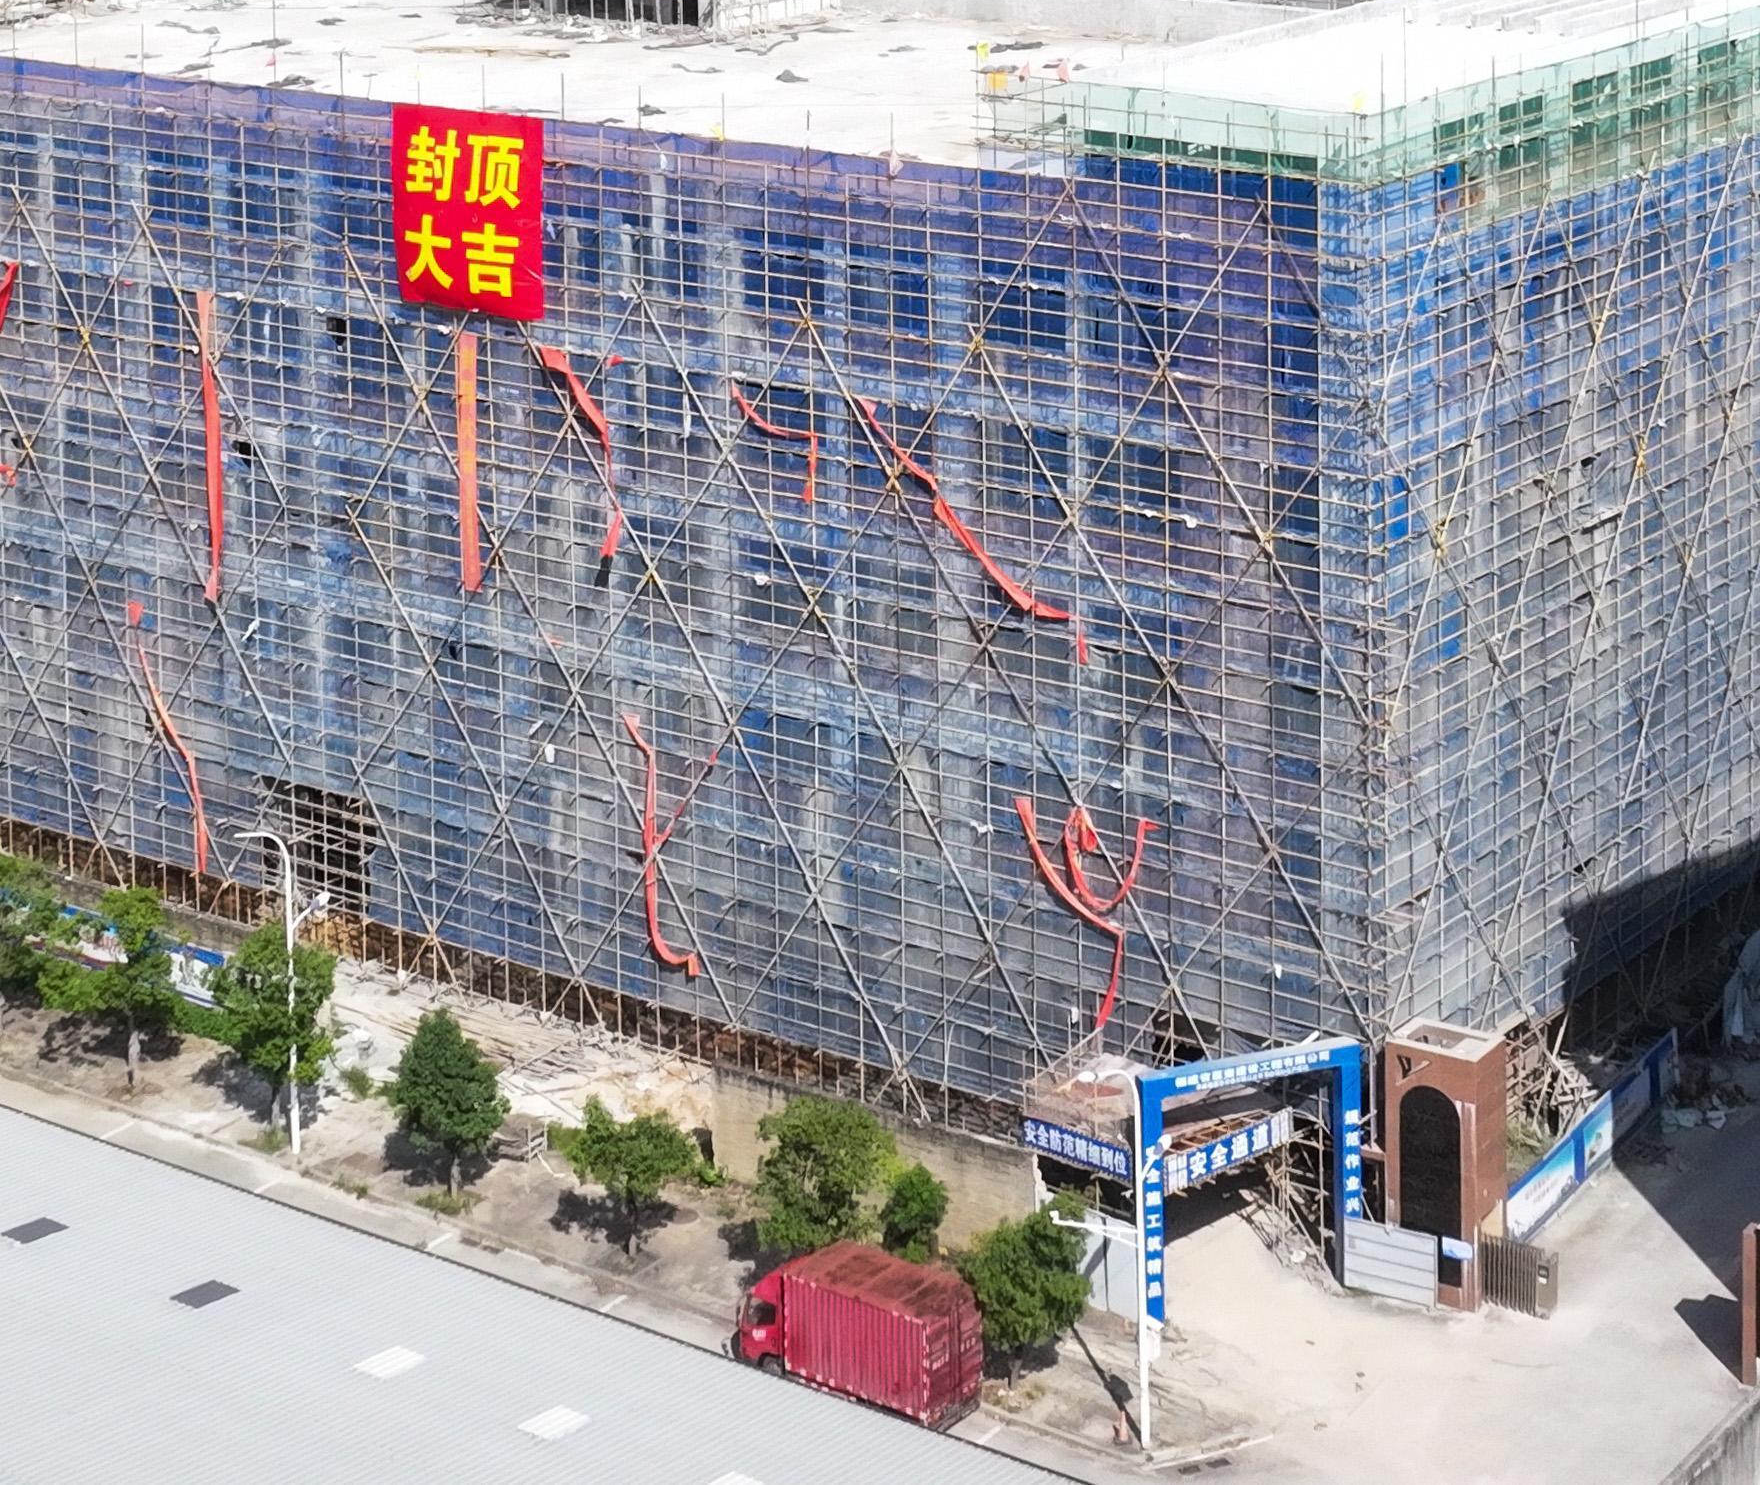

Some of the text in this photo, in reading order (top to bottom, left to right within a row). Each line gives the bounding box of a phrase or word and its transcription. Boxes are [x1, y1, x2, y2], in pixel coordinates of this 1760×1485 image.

[405, 125, 524, 209] 封顶
[404, 214, 520, 298] 大吉
[1023, 1119, 1128, 1176] 安全防范精细到位
[1189, 1123, 1269, 1180] 安全通道
